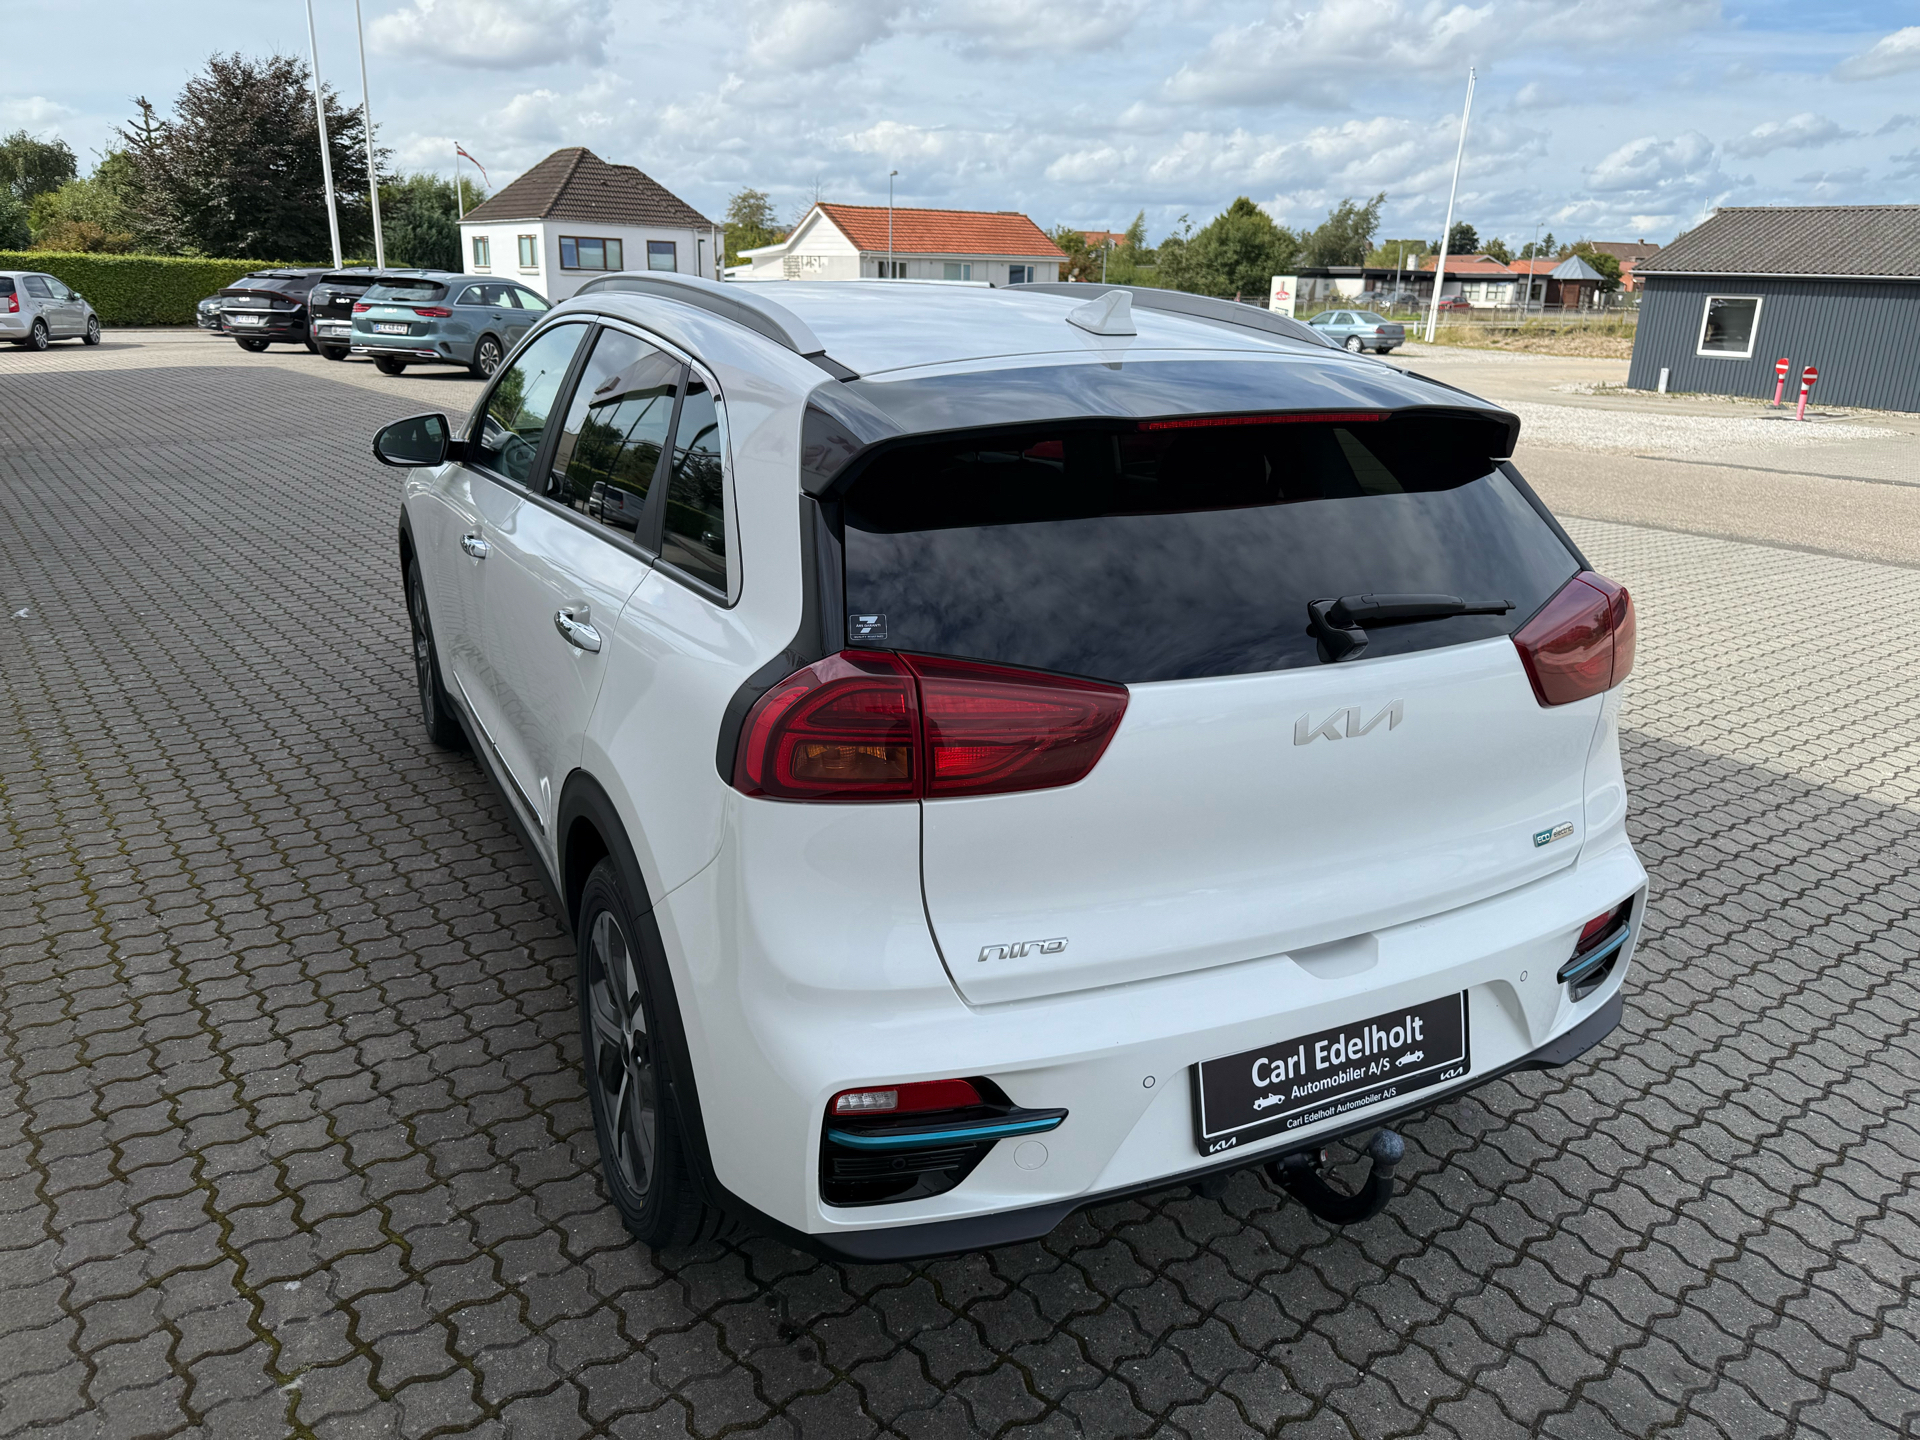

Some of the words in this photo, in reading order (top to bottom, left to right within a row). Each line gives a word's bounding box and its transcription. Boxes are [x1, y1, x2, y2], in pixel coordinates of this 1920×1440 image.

[1553, 825, 1572, 837] electric
[1251, 1044, 1306, 1088] Carl
[1314, 1015, 1424, 1070] Edelholt
[1291, 1067, 1366, 1100] Automobiler
[1368, 1057, 1391, 1076] A/S
[1286, 1115, 1303, 1129] Carl
[1304, 1106, 1335, 1123] Edelholt
[1336, 1093, 1382, 1113] Automobiler
[1383, 1087, 1397, 1099] A/S
